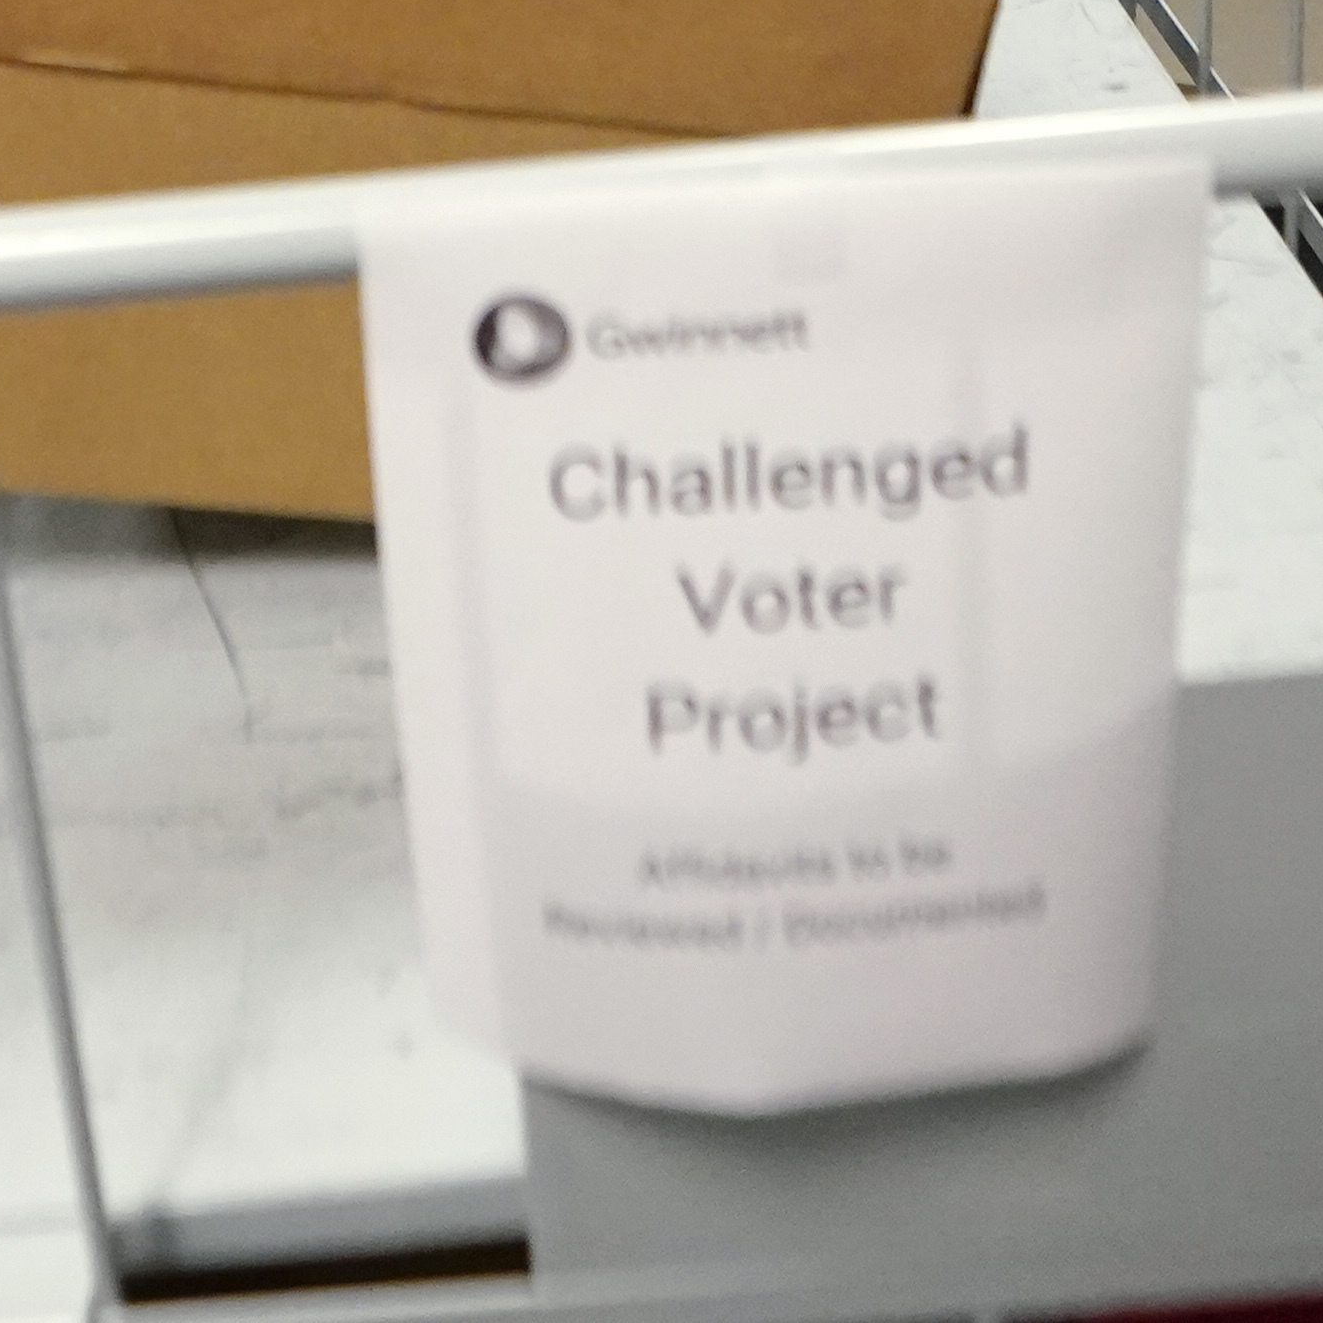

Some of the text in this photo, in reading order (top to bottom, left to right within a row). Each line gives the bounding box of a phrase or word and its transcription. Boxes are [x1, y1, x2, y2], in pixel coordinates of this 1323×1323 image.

[585, 308, 809, 361] Gwinnett
[548, 423, 1030, 522] Challenged
[676, 562, 910, 636] Voter
[645, 676, 942, 764] Project
